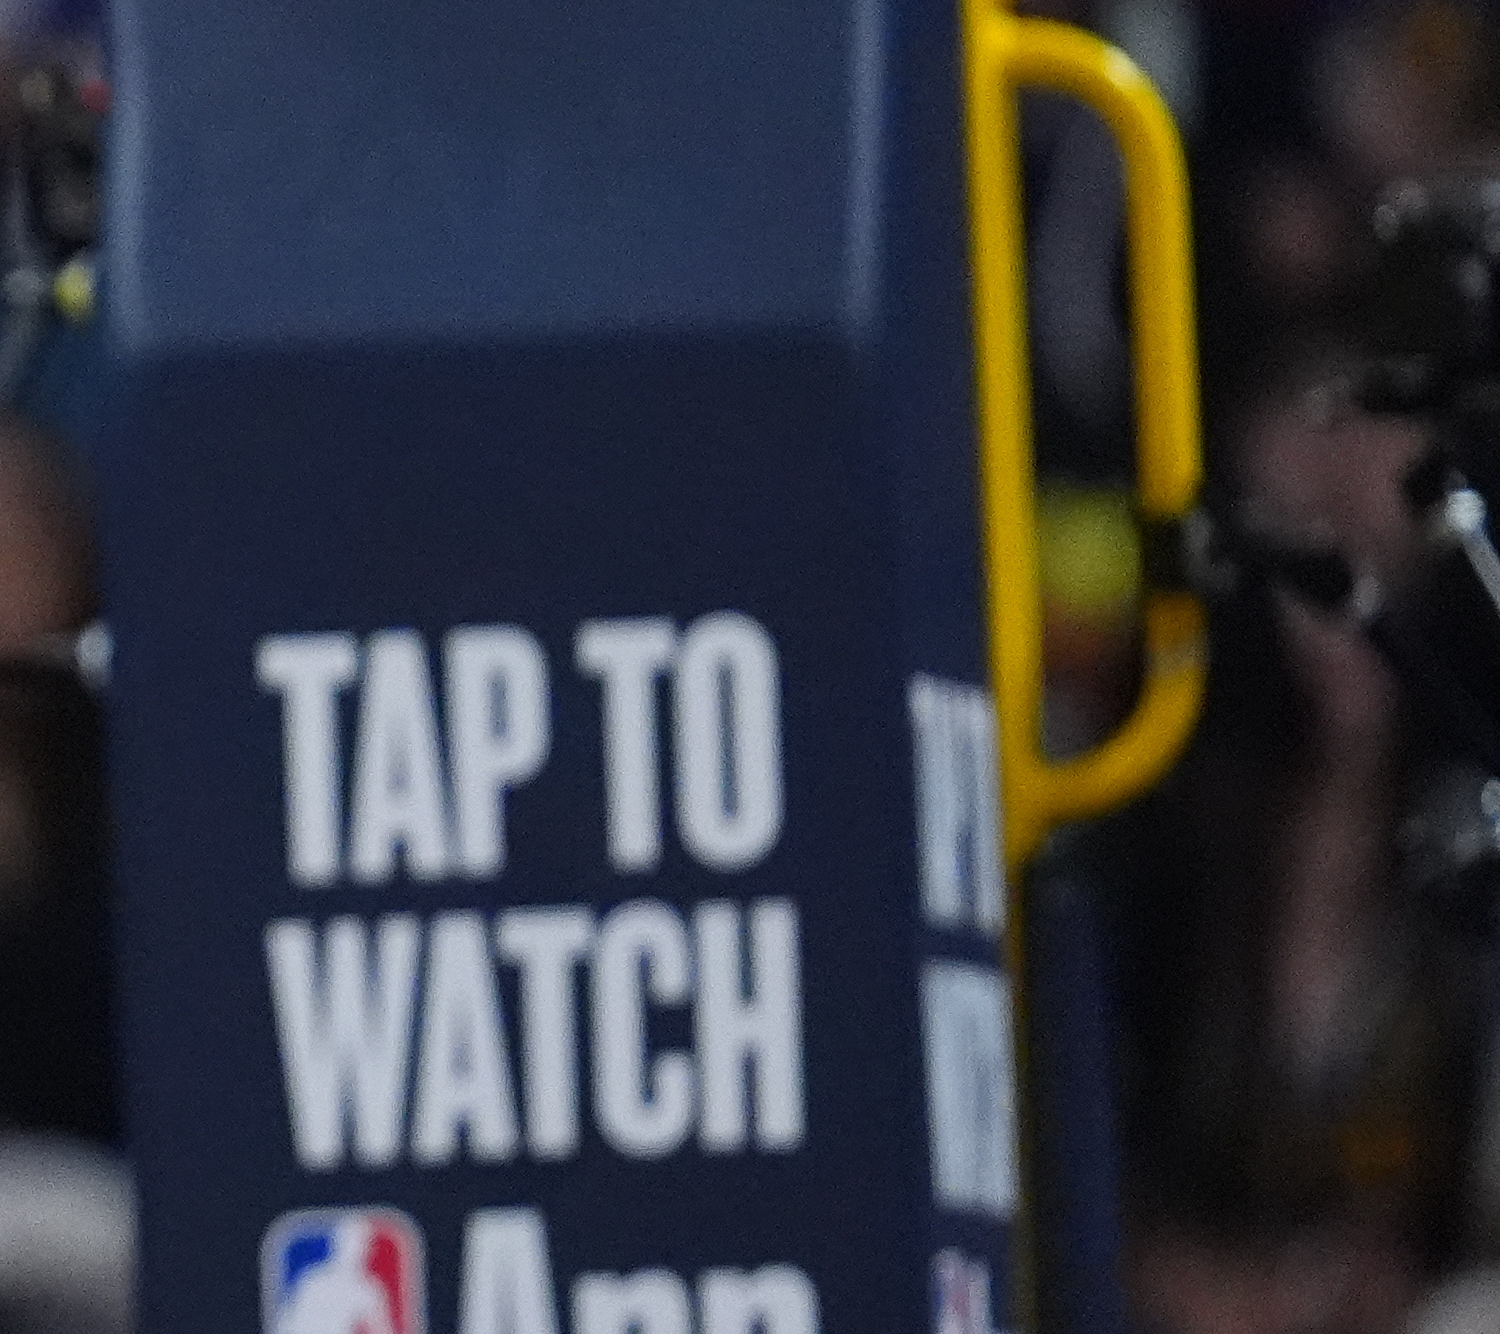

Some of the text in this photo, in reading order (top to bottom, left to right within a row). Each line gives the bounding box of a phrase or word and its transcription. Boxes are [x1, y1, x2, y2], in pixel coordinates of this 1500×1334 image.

[256, 625, 550, 886] TAP
[575, 612, 783, 871] TO
[265, 900, 804, 1168] WATCH
